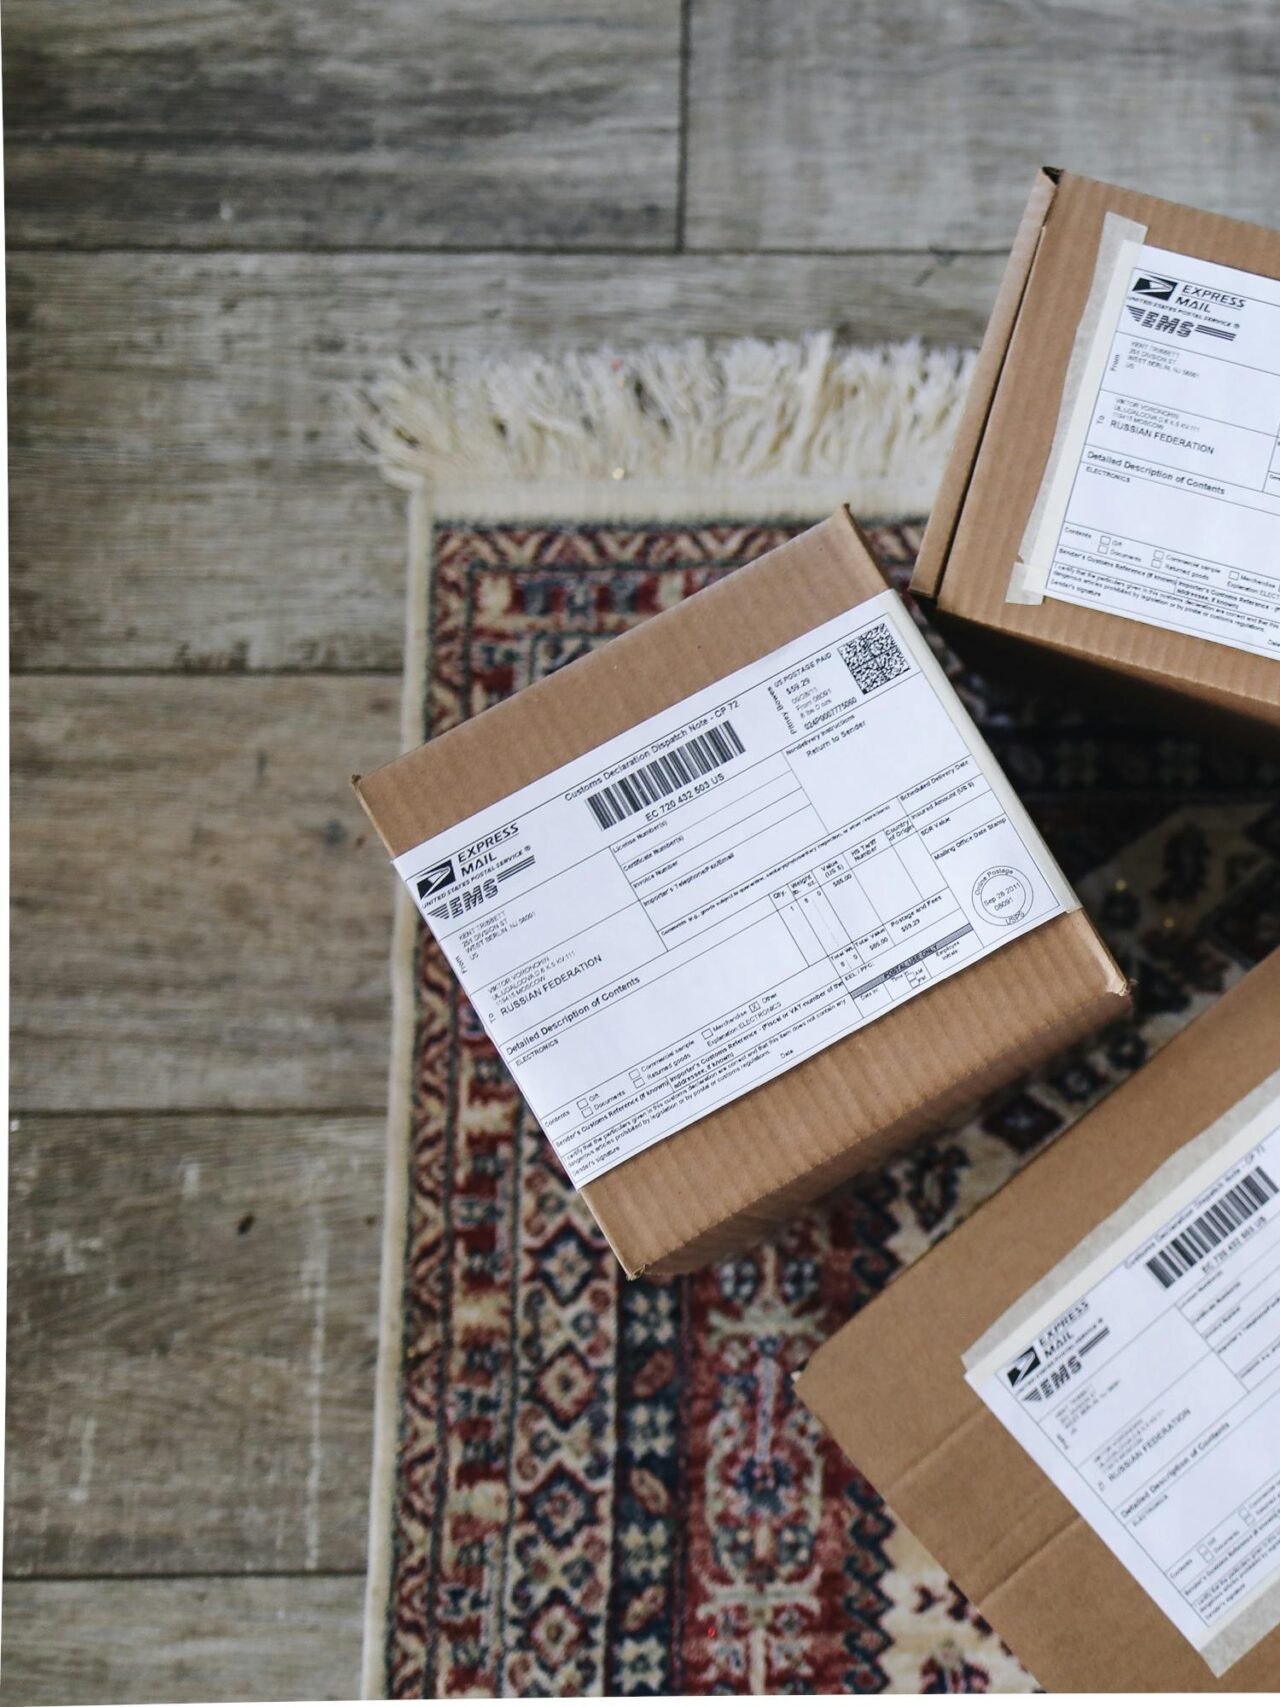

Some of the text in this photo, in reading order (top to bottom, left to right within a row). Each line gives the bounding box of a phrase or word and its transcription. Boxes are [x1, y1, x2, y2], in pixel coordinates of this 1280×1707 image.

[1175, 296, 1210, 313] MAIL
[1181, 284, 1246, 308] EXPRESS
[1141, 311, 1195, 338] EMS
[1110, 419, 1153, 438] RUSSIAN
[1153, 431, 1215, 455] FEDERATION
[1087, 450, 1225, 495] Detailed Description of Contents
[774, 652, 832, 688] US POSTAGE PAID
[785, 677, 810, 695] $59.29
[564, 700, 739, 802] Customs Declaration Dispatch Note CP 72
[805, 720, 866, 757] Return to Sender
[644, 772, 725, 822] EC 720 432 503 US
[457, 822, 519, 864] EXPRESS
[883, 819, 912, 839] Country
[933, 817, 1007, 860] Mailing Office Date Stamp
[447, 879, 470, 896] STATES
[470, 865, 496, 882] POSTAL
[496, 849, 523, 869] SERVICE
[460, 852, 497, 877] MAIL
[449, 878, 499, 919] EMS
[890, 895, 942, 928] Postage and Fees
[981, 880, 1021, 907] Sep 28 2011
[1004, 909, 1026, 927] USPS
[500, 987, 542, 1016] RUSSIAN
[542, 954, 602, 993] FEDERATION
[506, 977, 641, 1056] Detailed Description of Contents
[1038, 1301, 1089, 1347] EXPRESS
[1044, 1332, 1072, 1358] MAIL
[1040, 1355, 1082, 1399] EMS
[1108, 1451, 1143, 1482] RUSSIAN
[1142, 1408, 1191, 1453] FEDERATION
